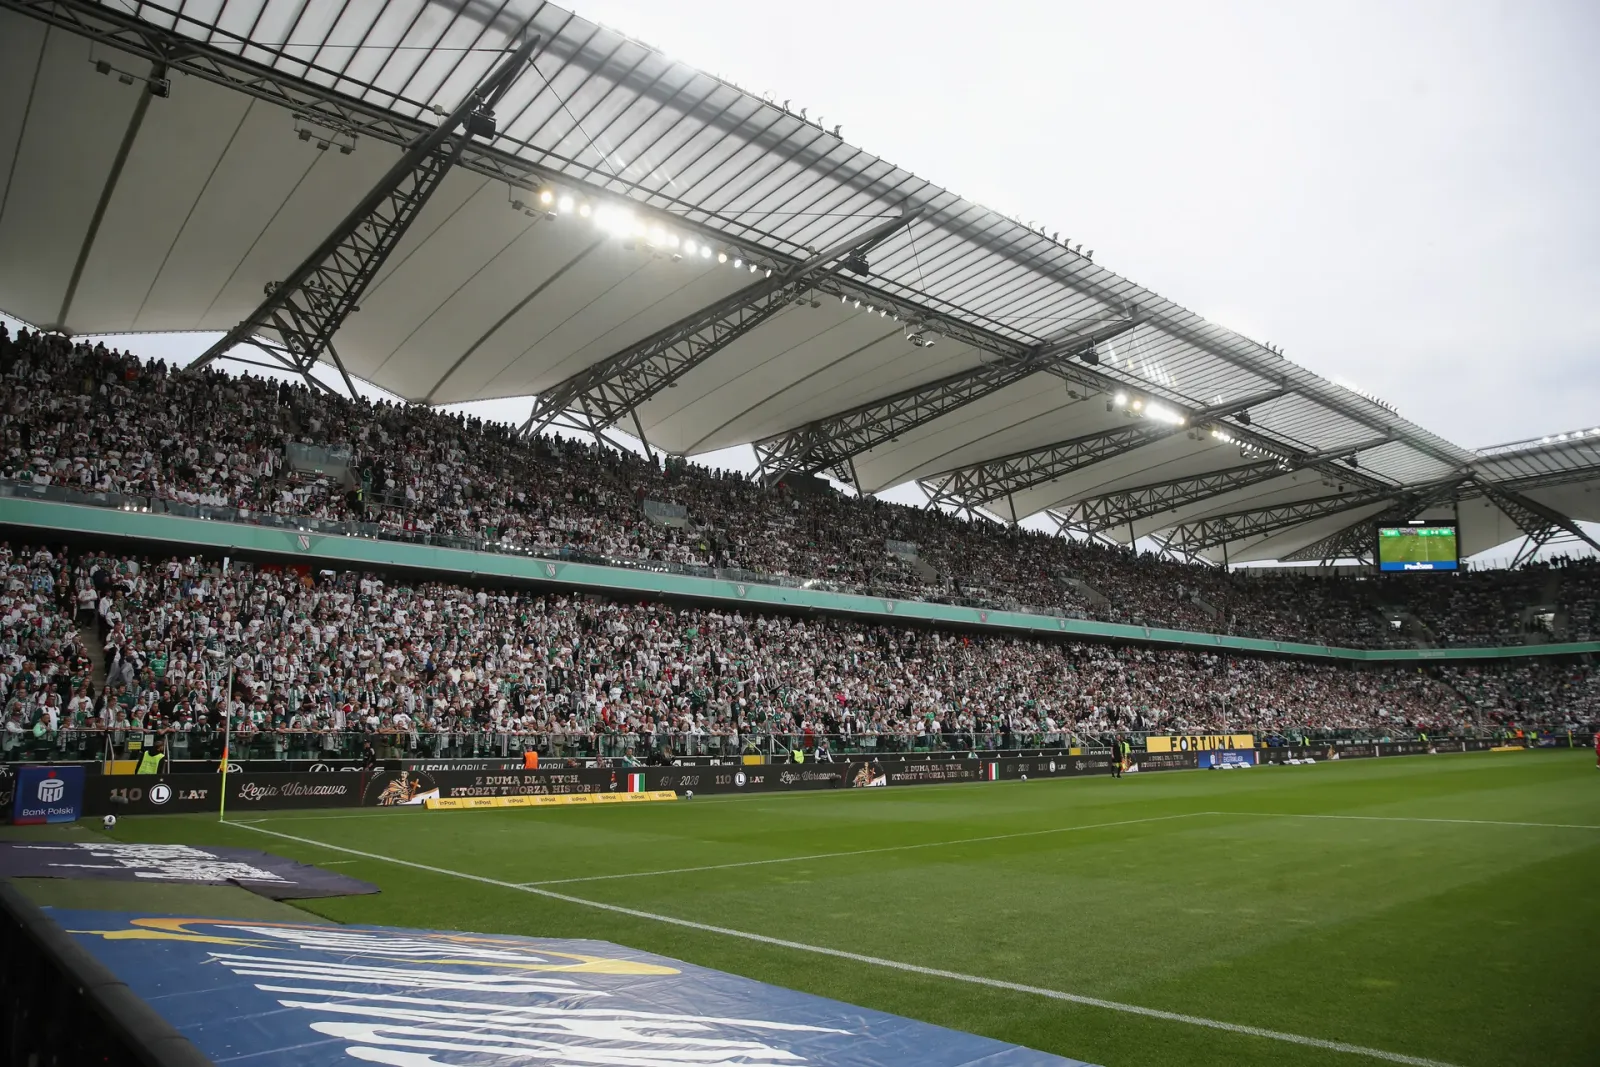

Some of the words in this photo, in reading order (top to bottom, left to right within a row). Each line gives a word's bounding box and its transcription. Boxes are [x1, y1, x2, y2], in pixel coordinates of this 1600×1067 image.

[1170, 736, 1235, 751] FORTUNA
[486, 776, 520, 786] DUMĄ
[524, 776, 546, 784] DLA
[716, 775, 731, 784] 110
[179, 790, 208, 800] LAT
[239, 782, 278, 800] Legia
[281, 782, 347, 797] Warszawa
[451, 785, 497, 796] KTÓRZY
